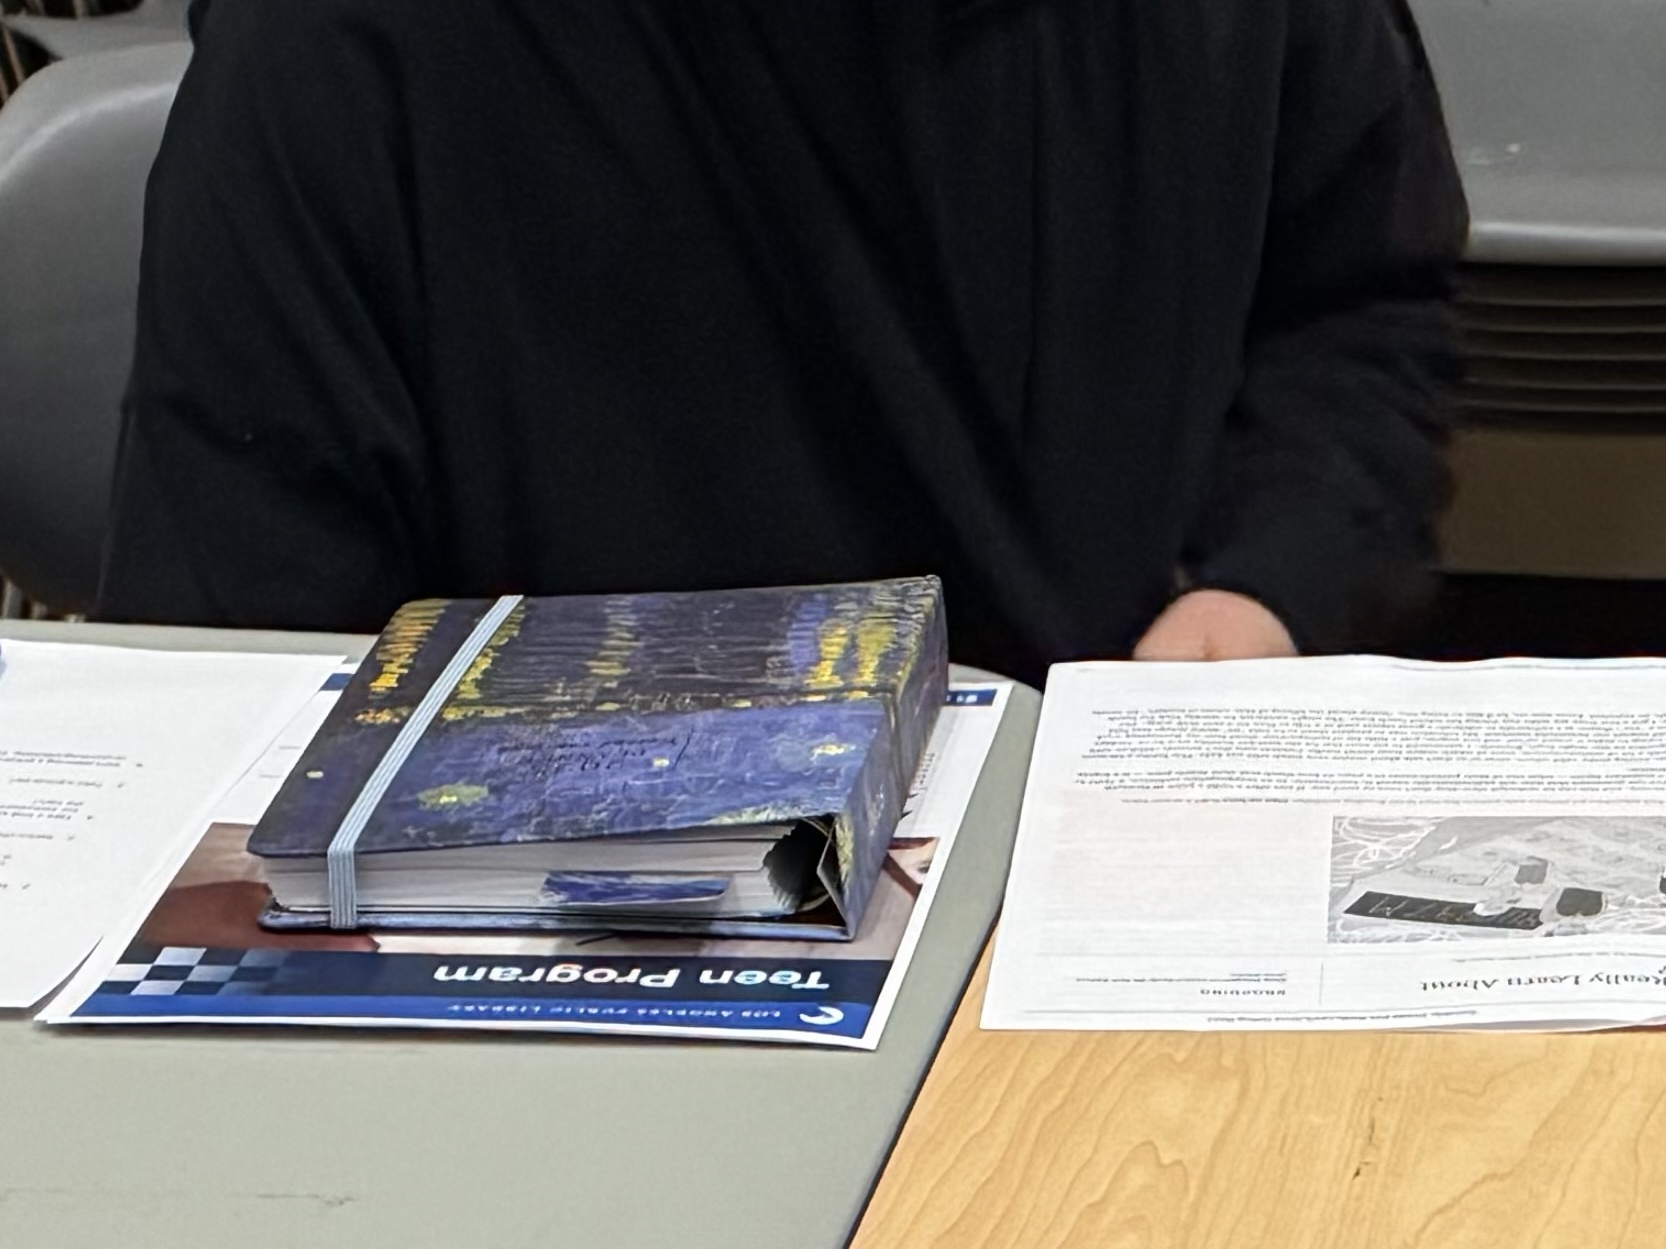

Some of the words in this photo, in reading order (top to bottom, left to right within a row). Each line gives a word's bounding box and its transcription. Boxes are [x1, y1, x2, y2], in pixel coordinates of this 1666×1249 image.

[433, 961, 680, 989] Program
[697, 967, 831, 990] Teen
[1506, 974, 1582, 987] Learn
[1417, 978, 1499, 992] About
[447, 1004, 541, 1014] LIBRARY
[549, 1005, 629, 1016] PUBLIC
[636, 1007, 734, 1019] ANGELES
[740, 1008, 782, 1019] LOS
